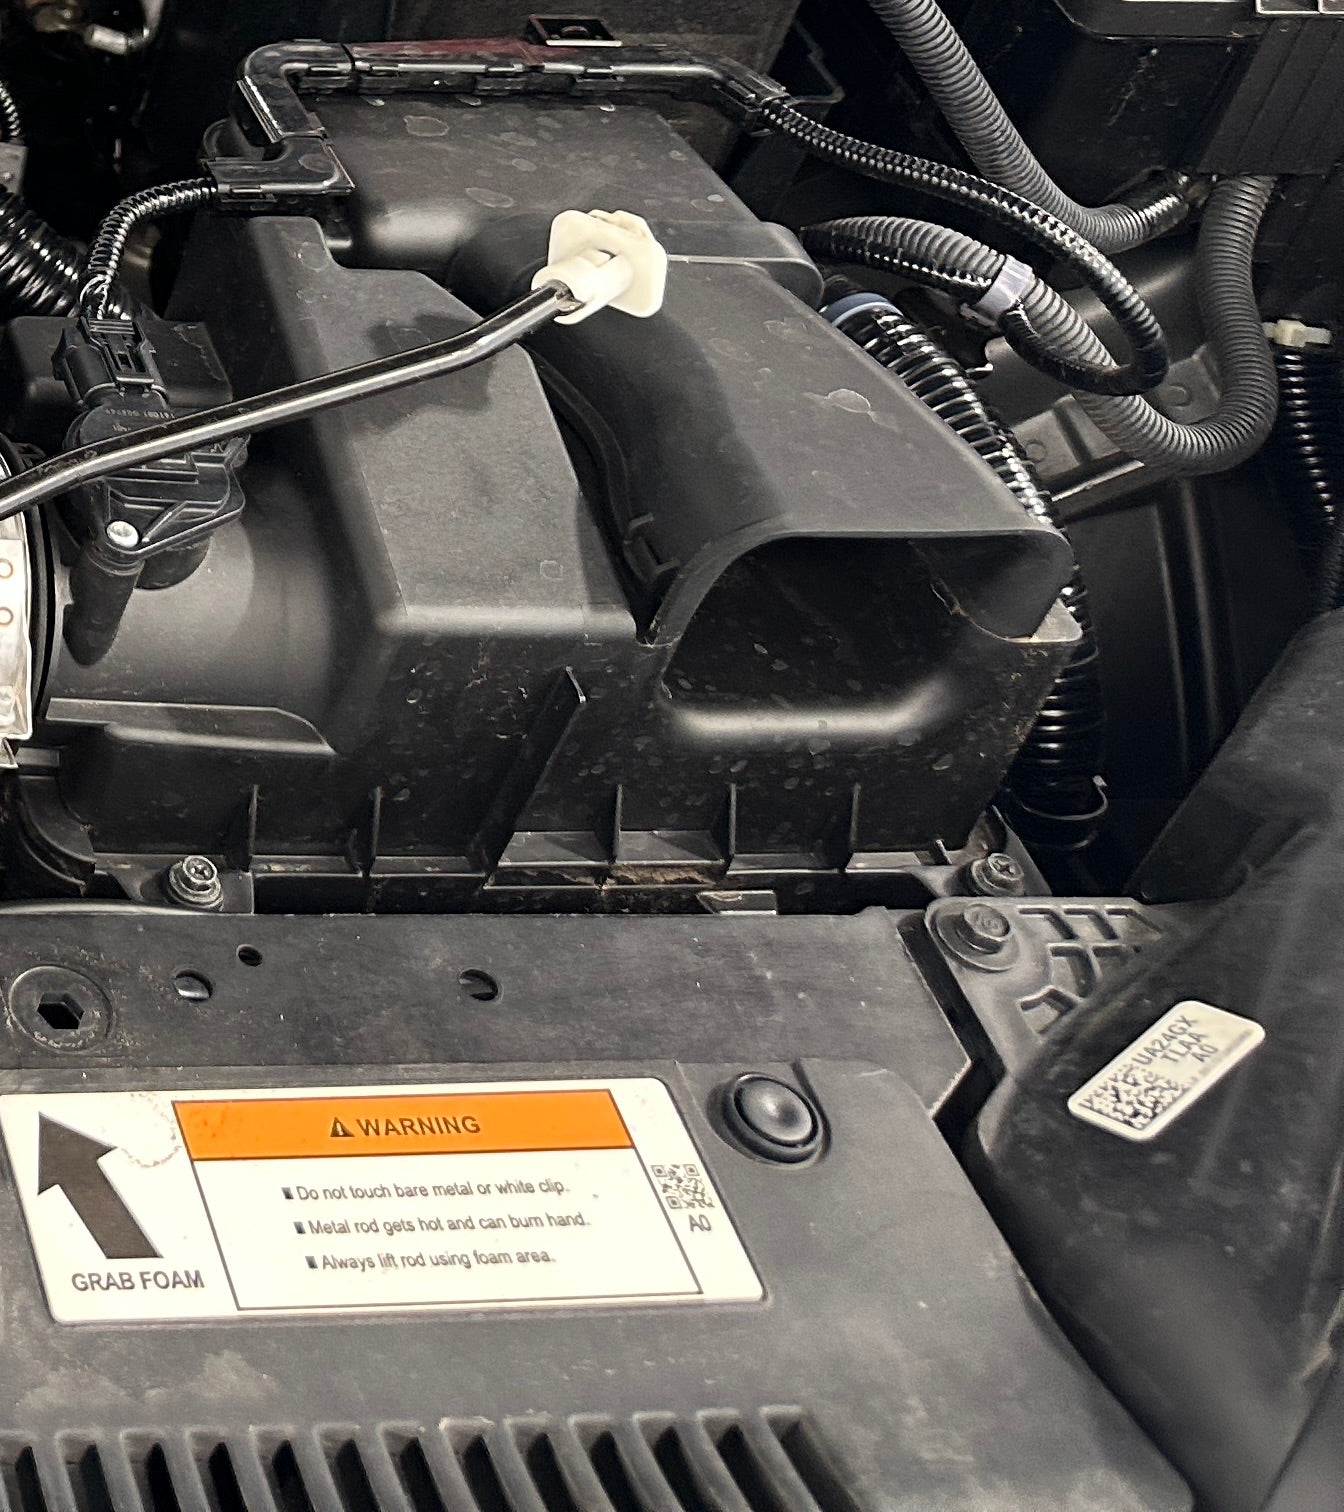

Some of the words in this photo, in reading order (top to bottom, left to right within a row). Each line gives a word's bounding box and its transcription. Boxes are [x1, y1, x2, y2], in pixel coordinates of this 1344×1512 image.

[356, 1115, 480, 1137] WARNING
[296, 1185, 319, 1201] Do
[323, 1186, 347, 1200] not
[350, 1184, 392, 1199] touch
[395, 1182, 429, 1198] bare
[432, 1181, 473, 1197] metal
[477, 1183, 491, 1195] or
[495, 1179, 535, 1195] white
[538, 1178, 571, 1196] clip.
[308, 1219, 351, 1235] Metal
[354, 1218, 380, 1234] rod
[383, 1218, 416, 1236] gets
[418, 1216, 444, 1232] hot
[447, 1215, 474, 1231] and
[479, 1215, 507, 1230] can
[545, 1211, 592, 1227] hand.
[322, 1254, 376, 1272] Always
[377, 1252, 399, 1269] lift
[401, 1252, 426, 1268] rod
[429, 1251, 472, 1269] using
[473, 1249, 514, 1265] foam
[516, 1250, 556, 1264] area.
[72, 1271, 136, 1291] GRAB
[139, 1269, 205, 1290] FOAM
